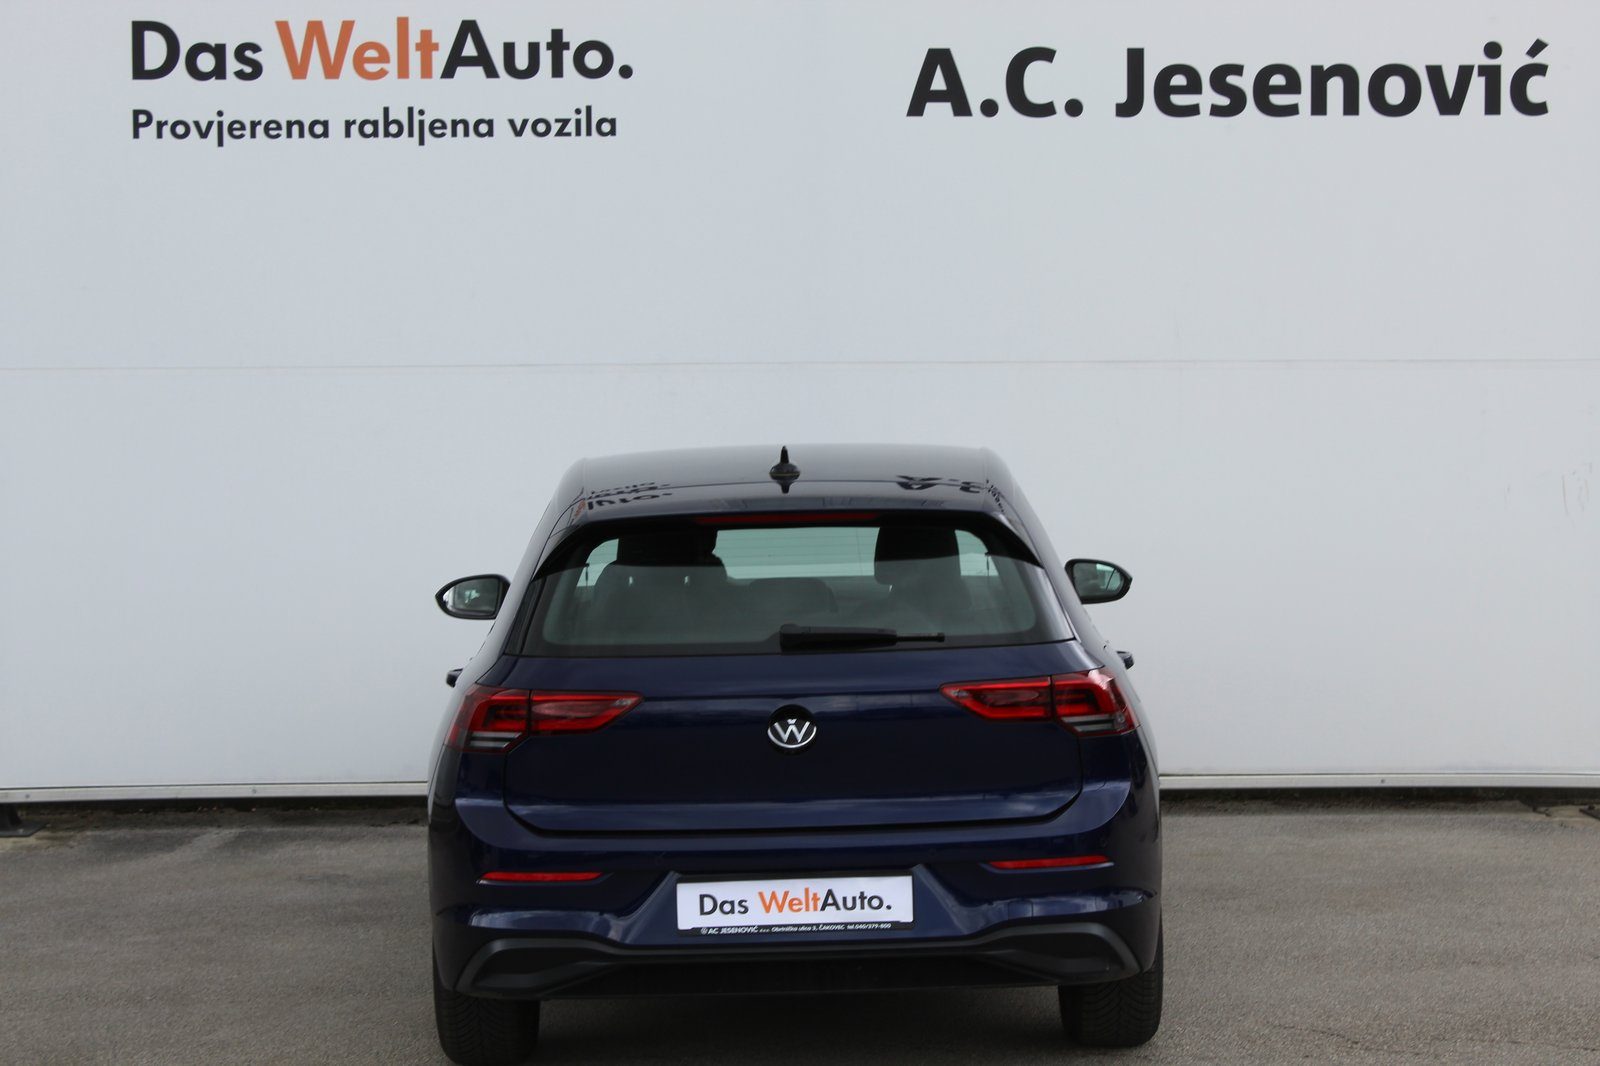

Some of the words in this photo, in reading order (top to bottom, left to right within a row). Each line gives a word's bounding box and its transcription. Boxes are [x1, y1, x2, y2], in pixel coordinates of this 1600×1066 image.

[132, 20, 263, 81] Das
[276, 16, 634, 80] WeltAuto.
[906, 47, 1084, 118] A.C.
[1116, 38, 1549, 118] Jesenović
[132, 108, 330, 147] Provjerena
[344, 105, 494, 147] rabljena
[508, 104, 617, 138] vozila
[698, 893, 750, 916] Das
[758, 887, 893, 914] WeltAuto.
